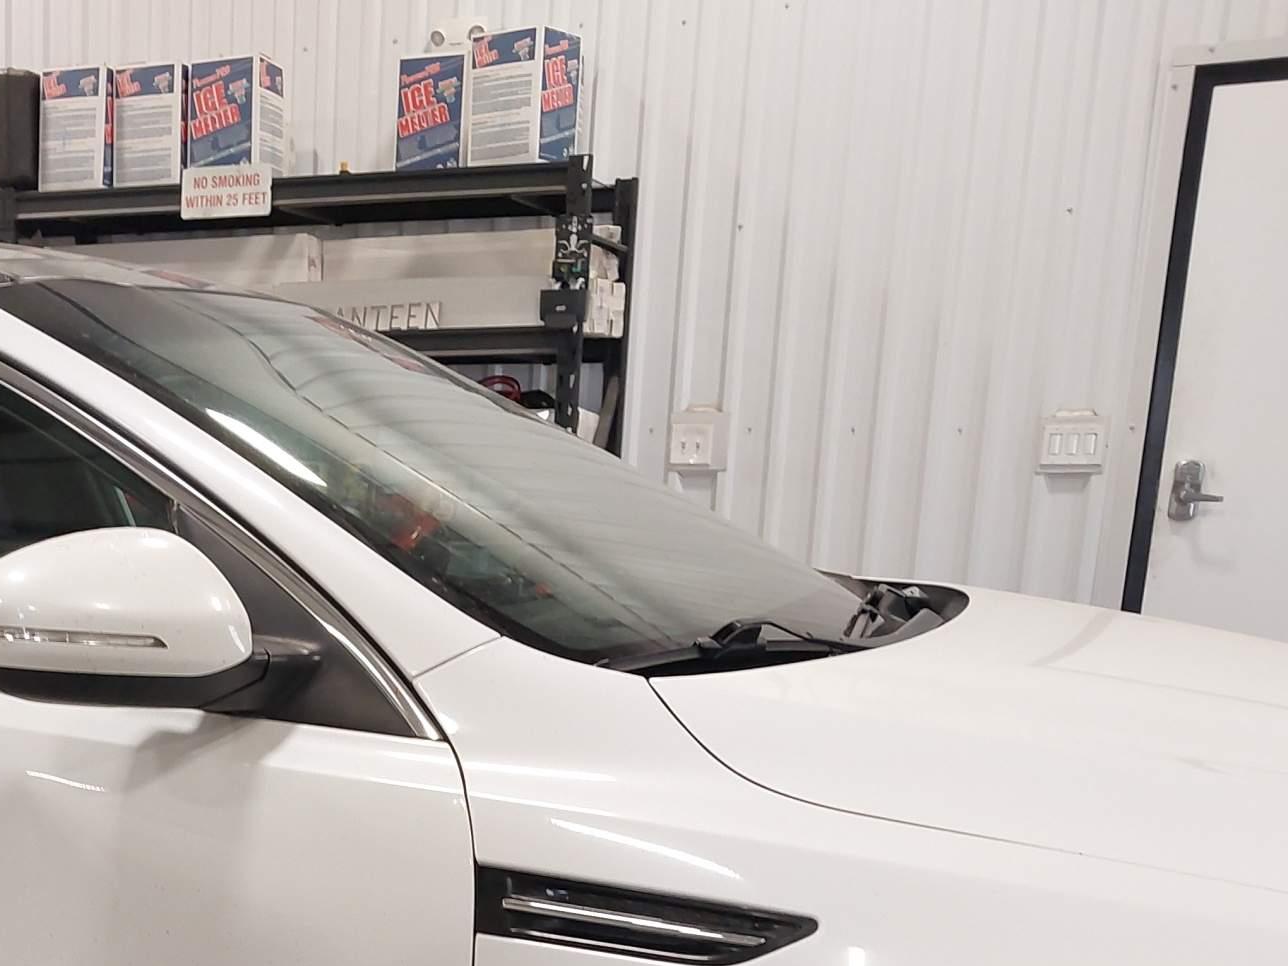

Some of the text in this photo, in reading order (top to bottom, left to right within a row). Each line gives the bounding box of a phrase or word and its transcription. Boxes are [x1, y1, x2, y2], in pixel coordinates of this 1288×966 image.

[545, 55, 567, 90] ICE
[193, 81, 228, 118] ICE
[400, 79, 437, 115] ICE
[397, 102, 450, 138] MELTER
[193, 172, 260, 190] NO SMOKING
[185, 191, 268, 208] WITHIN 25 FEET
